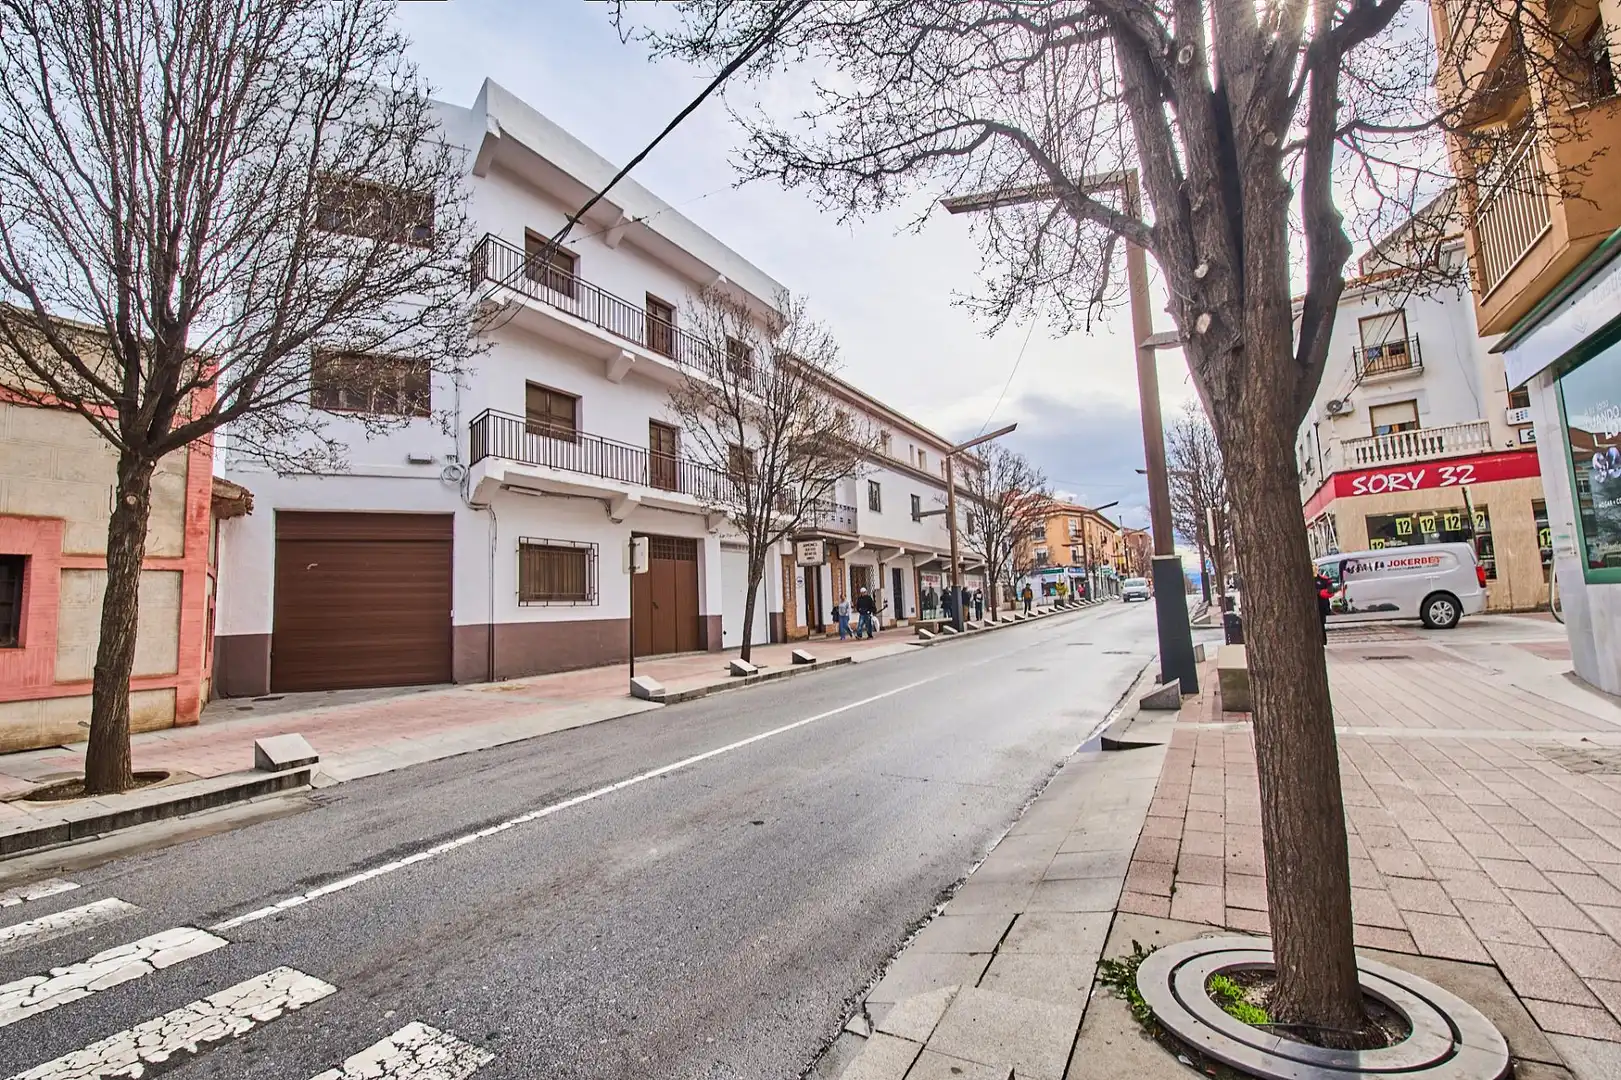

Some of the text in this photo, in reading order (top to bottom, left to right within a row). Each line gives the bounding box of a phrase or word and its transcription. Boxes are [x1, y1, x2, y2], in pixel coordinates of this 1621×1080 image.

[1352, 464, 1477, 495] SORY 32
[1398, 520, 1412, 534] 12
[1421, 518, 1435, 532] 12
[1446, 515, 1460, 530] 12
[1387, 556, 1441, 568] JOKERBET
